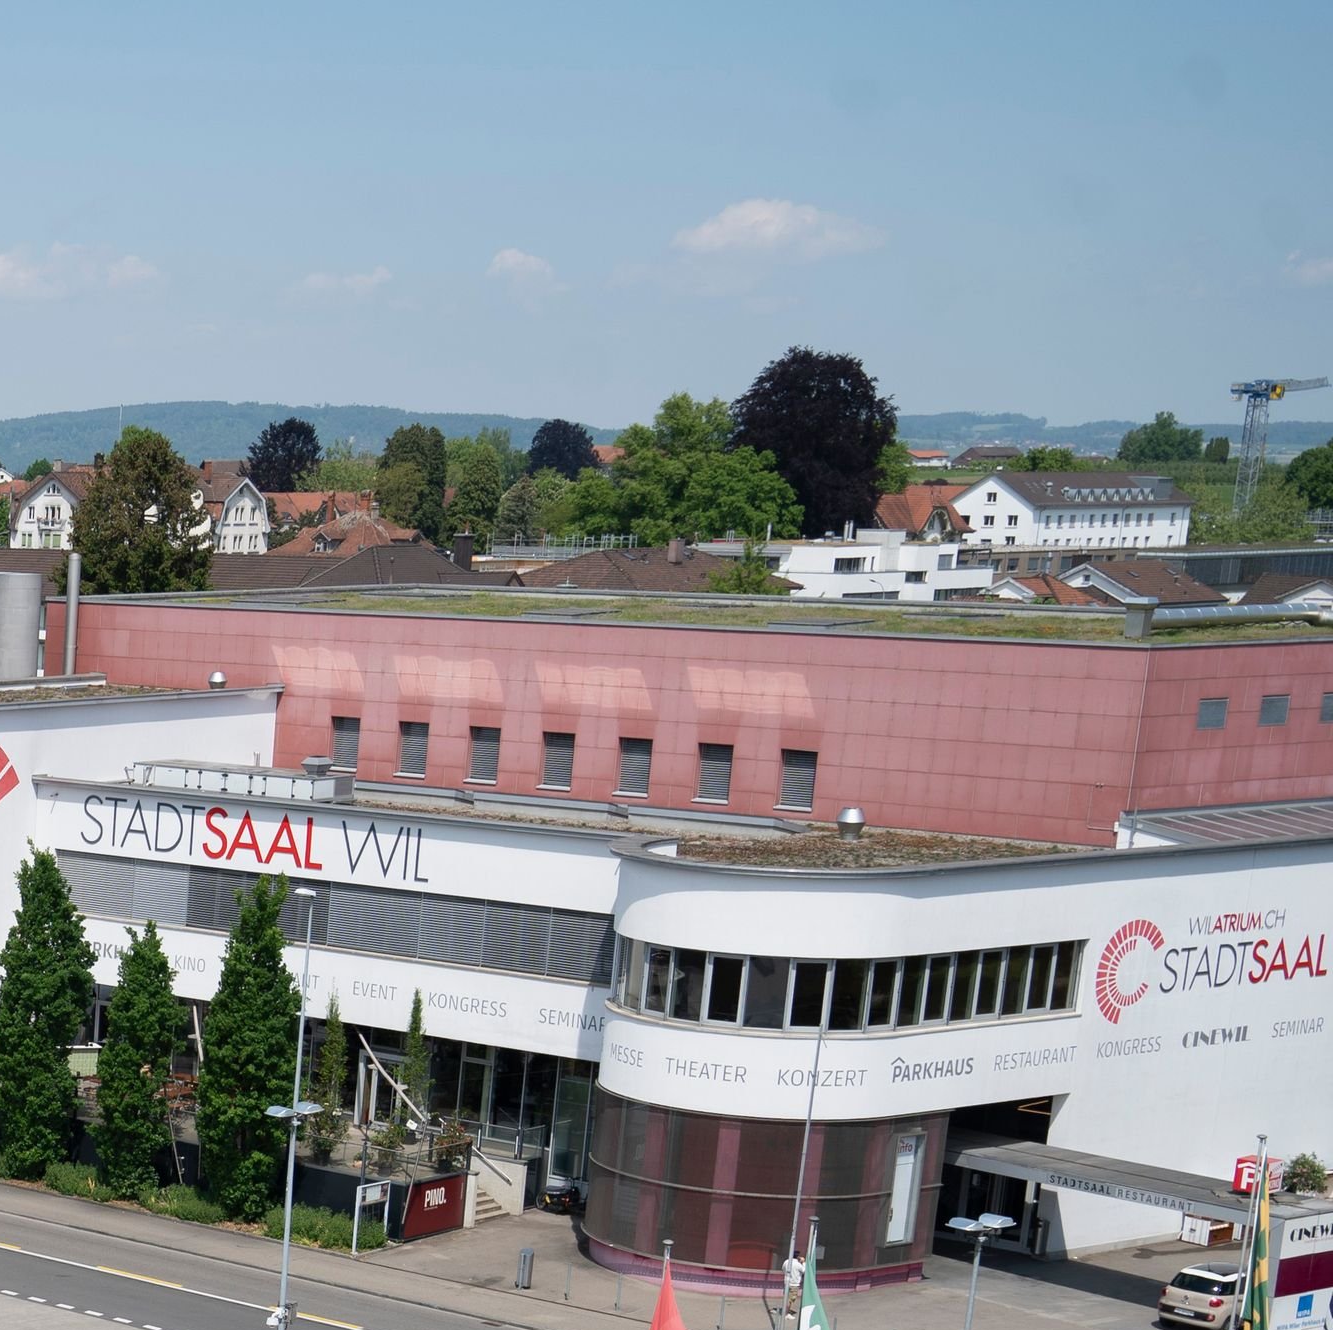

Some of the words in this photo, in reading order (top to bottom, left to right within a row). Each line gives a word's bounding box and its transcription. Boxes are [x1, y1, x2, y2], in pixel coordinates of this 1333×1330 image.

[80, 794, 323, 870] STADTSAAL
[342, 820, 428, 883] WIL
[1189, 908, 1286, 935] WILATRIUM.CH
[174, 955, 206, 973] KINO
[353, 980, 398, 1001] EVENT
[428, 992, 508, 1018] KONGRESS
[1159, 934, 1328, 993] STADTSAAL
[610, 1042, 644, 1068] MESSE
[665, 1057, 748, 1083] THEATER
[777, 1068, 868, 1087] KONZERT
[891, 1057, 974, 1083] PARKHAUS
[993, 1045, 1077, 1072] RESTAURANT
[1096, 1036, 1162, 1059] KONGRESS
[1182, 1025, 1251, 1049] CINEWIL
[1271, 1016, 1324, 1038] SEMINAR
[898, 1142, 913, 1153] info
[1048, 1174, 1112, 1196] STADTSAAL
[1117, 1188, 1193, 1211] RESTAURANT
